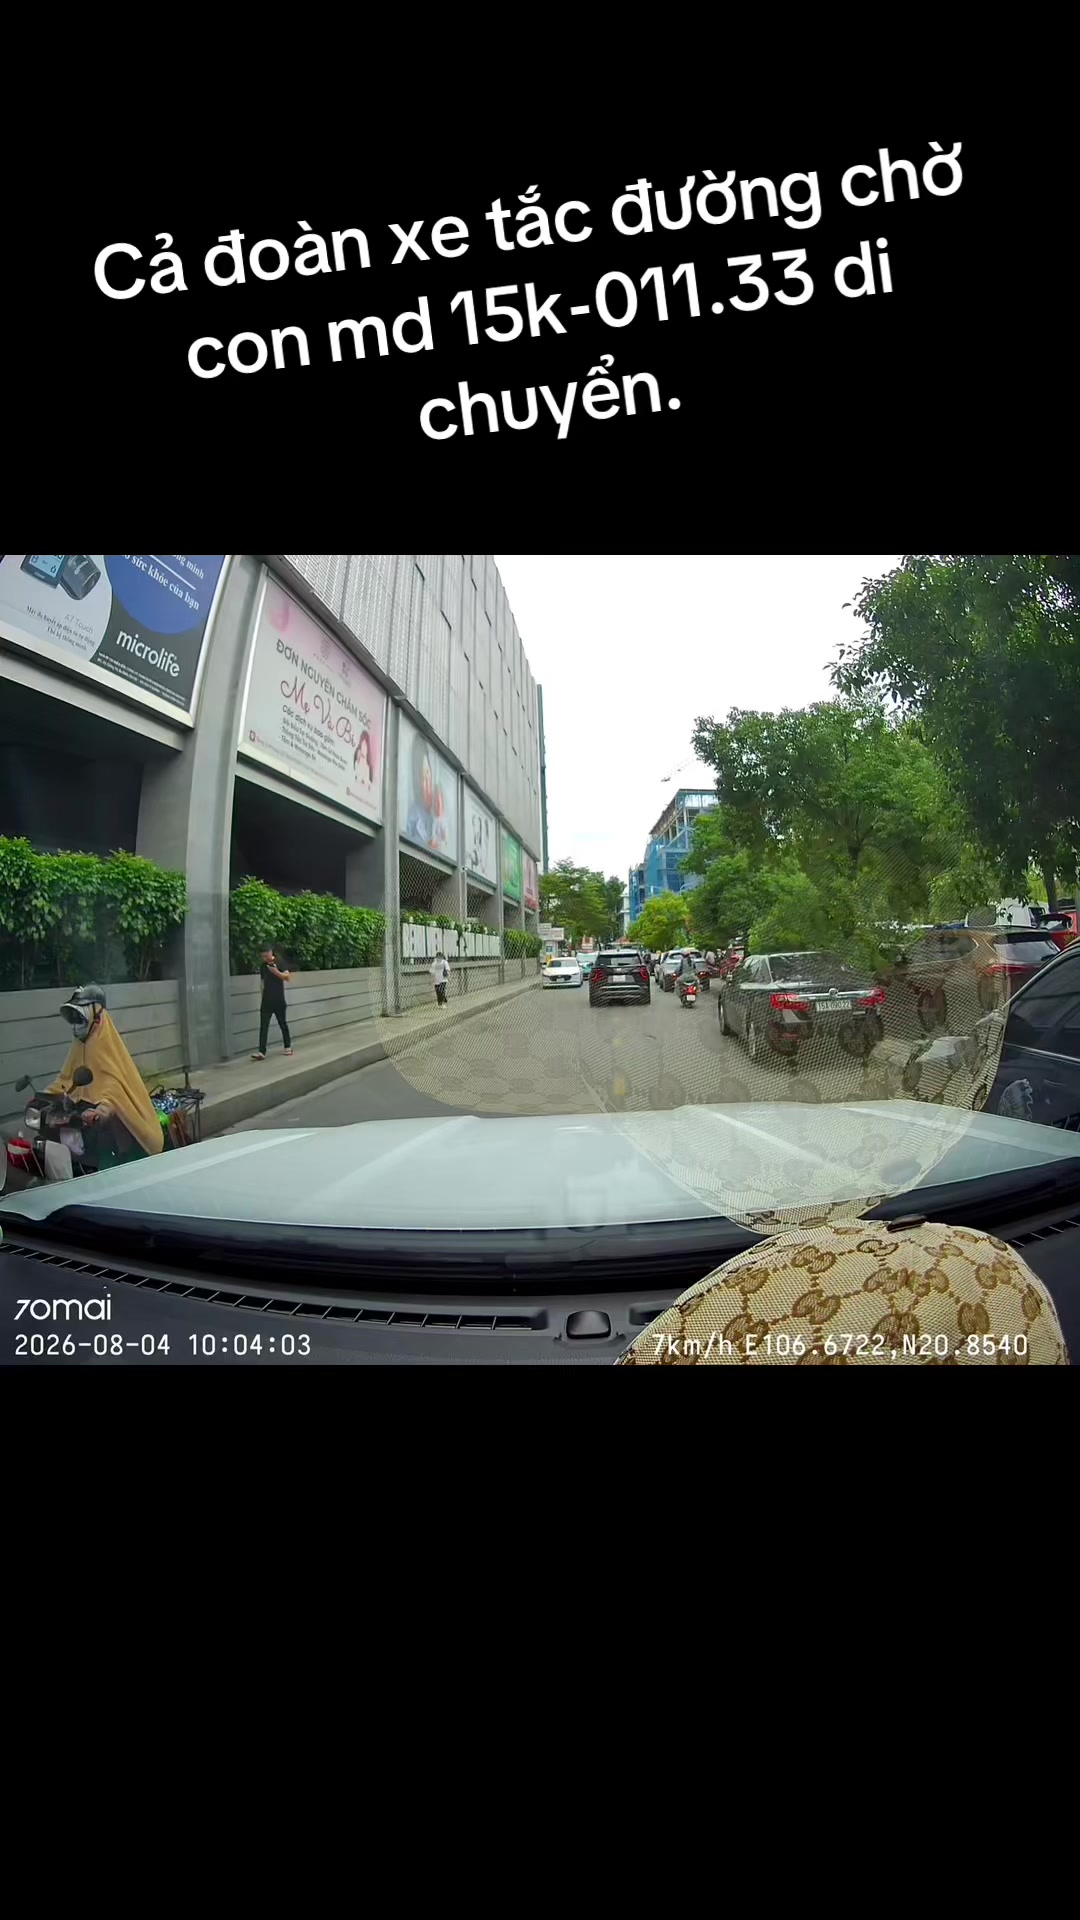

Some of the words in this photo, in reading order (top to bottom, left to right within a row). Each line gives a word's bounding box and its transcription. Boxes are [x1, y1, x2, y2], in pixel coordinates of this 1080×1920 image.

[186, 560, 204, 579] minh
[169, 583, 183, 598] của
[184, 592, 200, 610] bạn
[116, 630, 180, 677] microlife
[276, 639, 299, 667] ĐƠN
[301, 660, 335, 698] NGUYÊN
[280, 676, 310, 714] Mẹ
